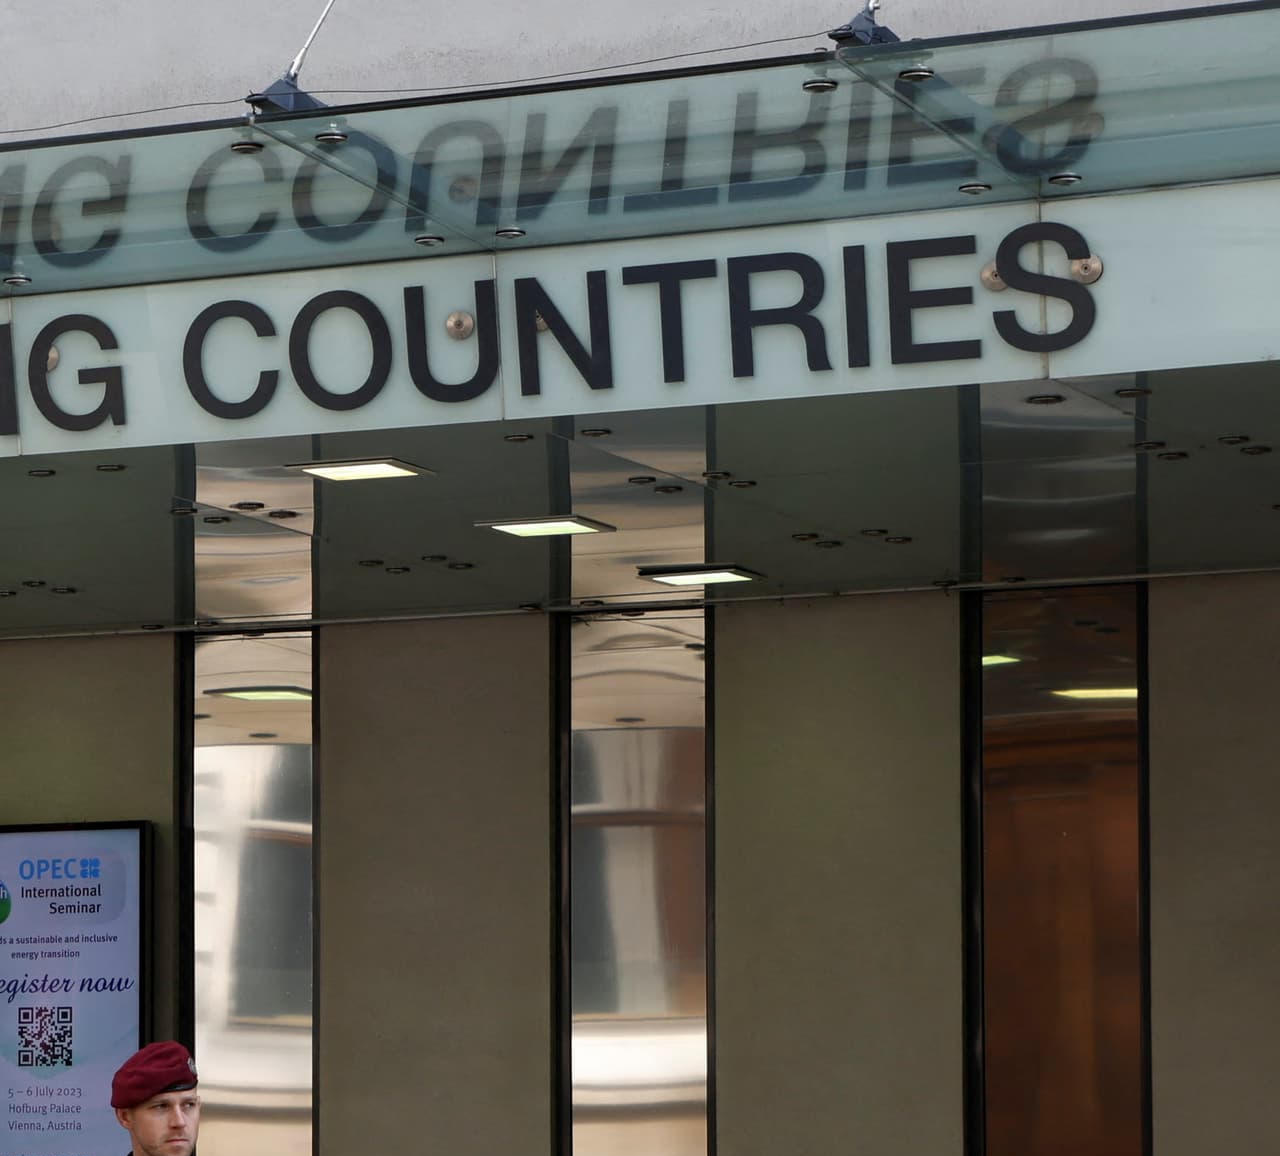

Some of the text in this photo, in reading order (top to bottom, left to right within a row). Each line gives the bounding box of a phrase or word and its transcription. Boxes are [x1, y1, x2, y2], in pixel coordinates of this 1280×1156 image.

[182, 221, 1097, 420] COUNTRIES
[18, 858, 77, 880] OPEC
[21, 884, 102, 898] International
[49, 901, 102, 914] Seminar
[15, 935, 62, 945] sustainable
[64, 934, 80, 943] and
[81, 933, 118, 943] inclusive
[11, 949, 80, 960] energy transition
[79, 976, 135, 993] now
[8, 1088, 14, 1099] 5
[26, 1086, 33, 1096] 6
[35, 1086, 54, 1098] July
[57, 1087, 82, 1098] 2023
[8, 1103, 82, 1115] Hofburg Palace
[8, 1120, 82, 1131] Vienna, Austria
